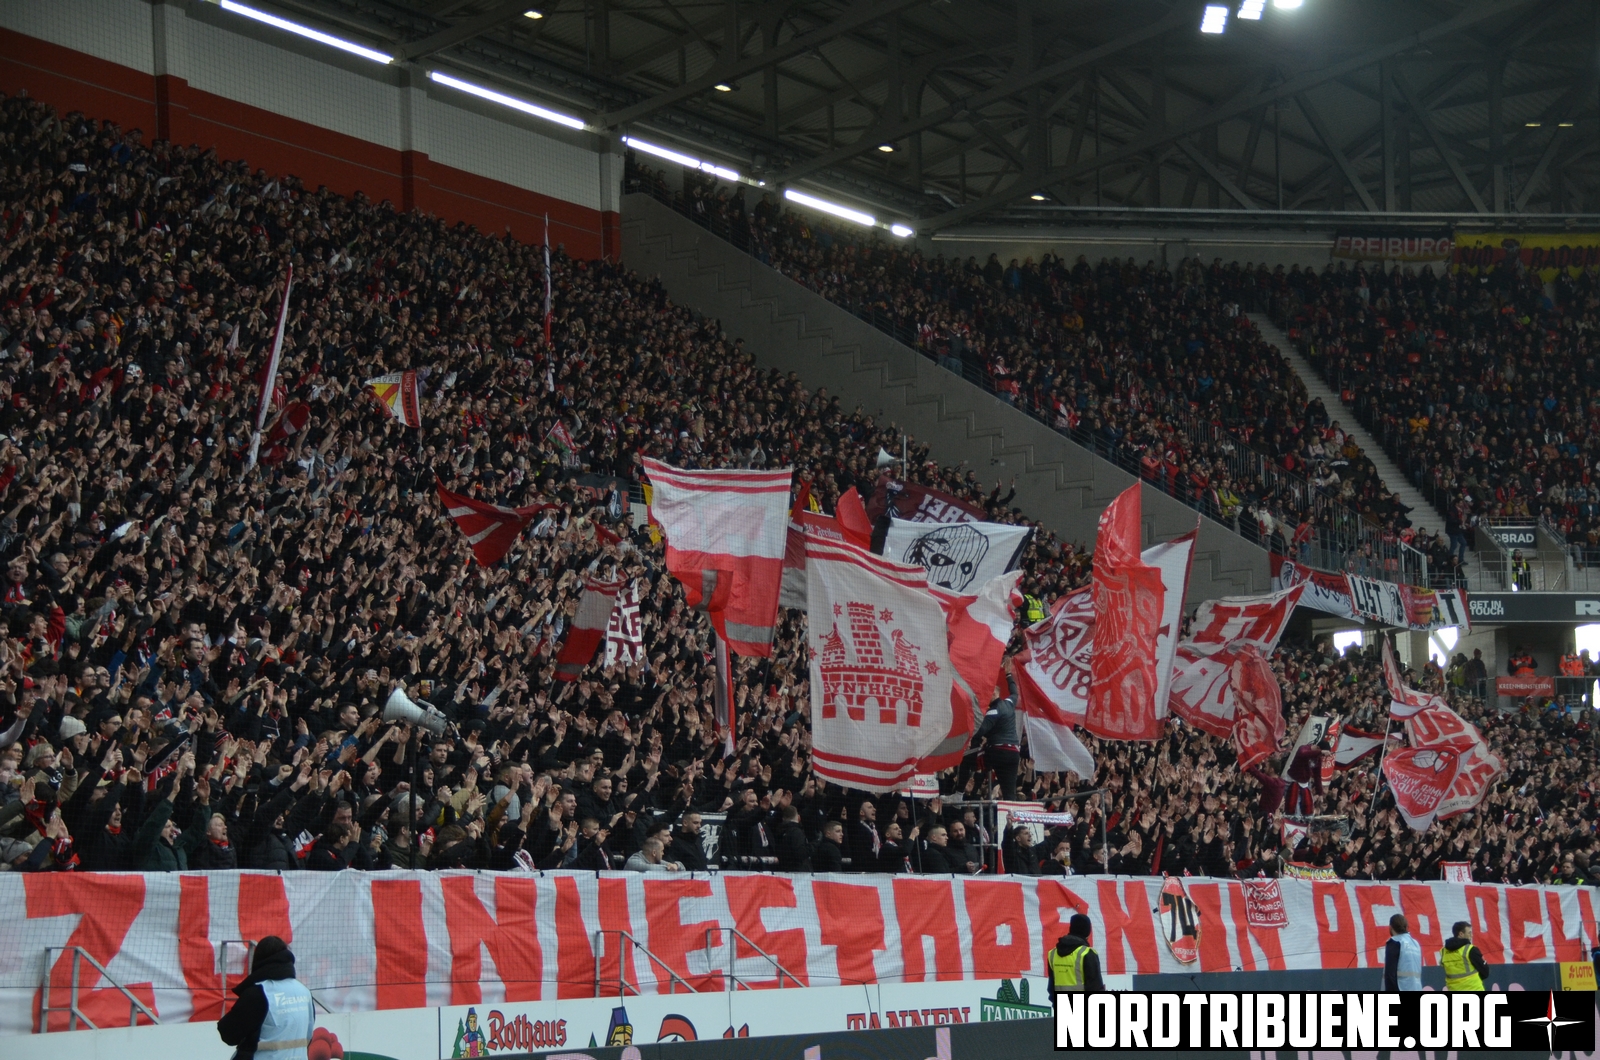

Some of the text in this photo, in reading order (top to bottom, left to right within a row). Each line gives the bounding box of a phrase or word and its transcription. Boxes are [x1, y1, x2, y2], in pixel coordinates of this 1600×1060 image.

[1336, 236, 1451, 258] FREIBURG
[1350, 574, 1384, 618] LIST
[1469, 600, 1489, 609] GET
[1469, 607, 1504, 616] TOUCH
[823, 681, 924, 704] SYNTHESIA
[22, 871, 294, 1035] ZU
[1187, 880, 1287, 973] IN
[1312, 880, 1441, 970] DER
[1575, 965, 1593, 978] LOTTO
[486, 1009, 568, 1053] Rothaus
